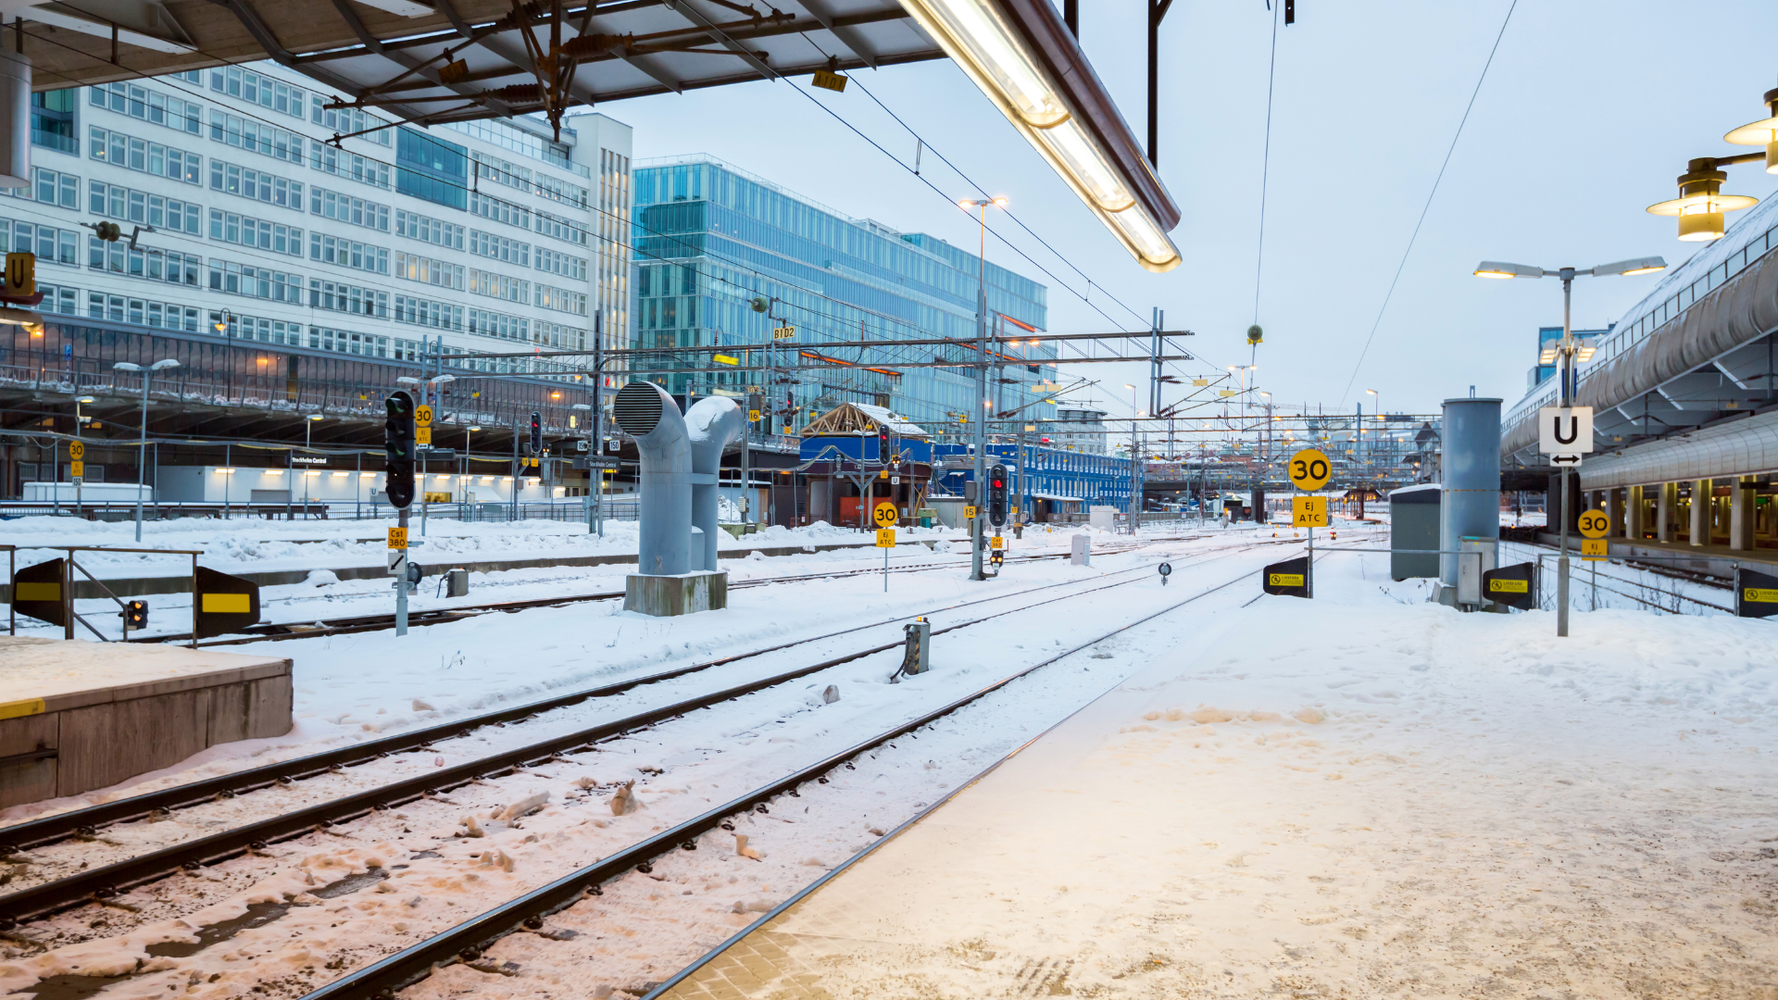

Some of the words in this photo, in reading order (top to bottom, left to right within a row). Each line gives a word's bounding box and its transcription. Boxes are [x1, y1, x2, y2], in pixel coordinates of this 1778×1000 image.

[12, 259, 24, 289] U
[416, 410, 431, 421] 30
[1554, 416, 1578, 445] U
[71, 443, 83, 455] 30
[611, 441, 619, 450] 150
[1293, 459, 1328, 480] 30
[965, 508, 974, 516] 15
[1305, 502, 1314, 512] Ej
[876, 509, 896, 521] 30
[1299, 514, 1320, 522] ATC
[1582, 516, 1608, 531] 30
[391, 529, 404, 538] Cst
[389, 539, 405, 547] 380
[1591, 543, 1598, 551] Ej
